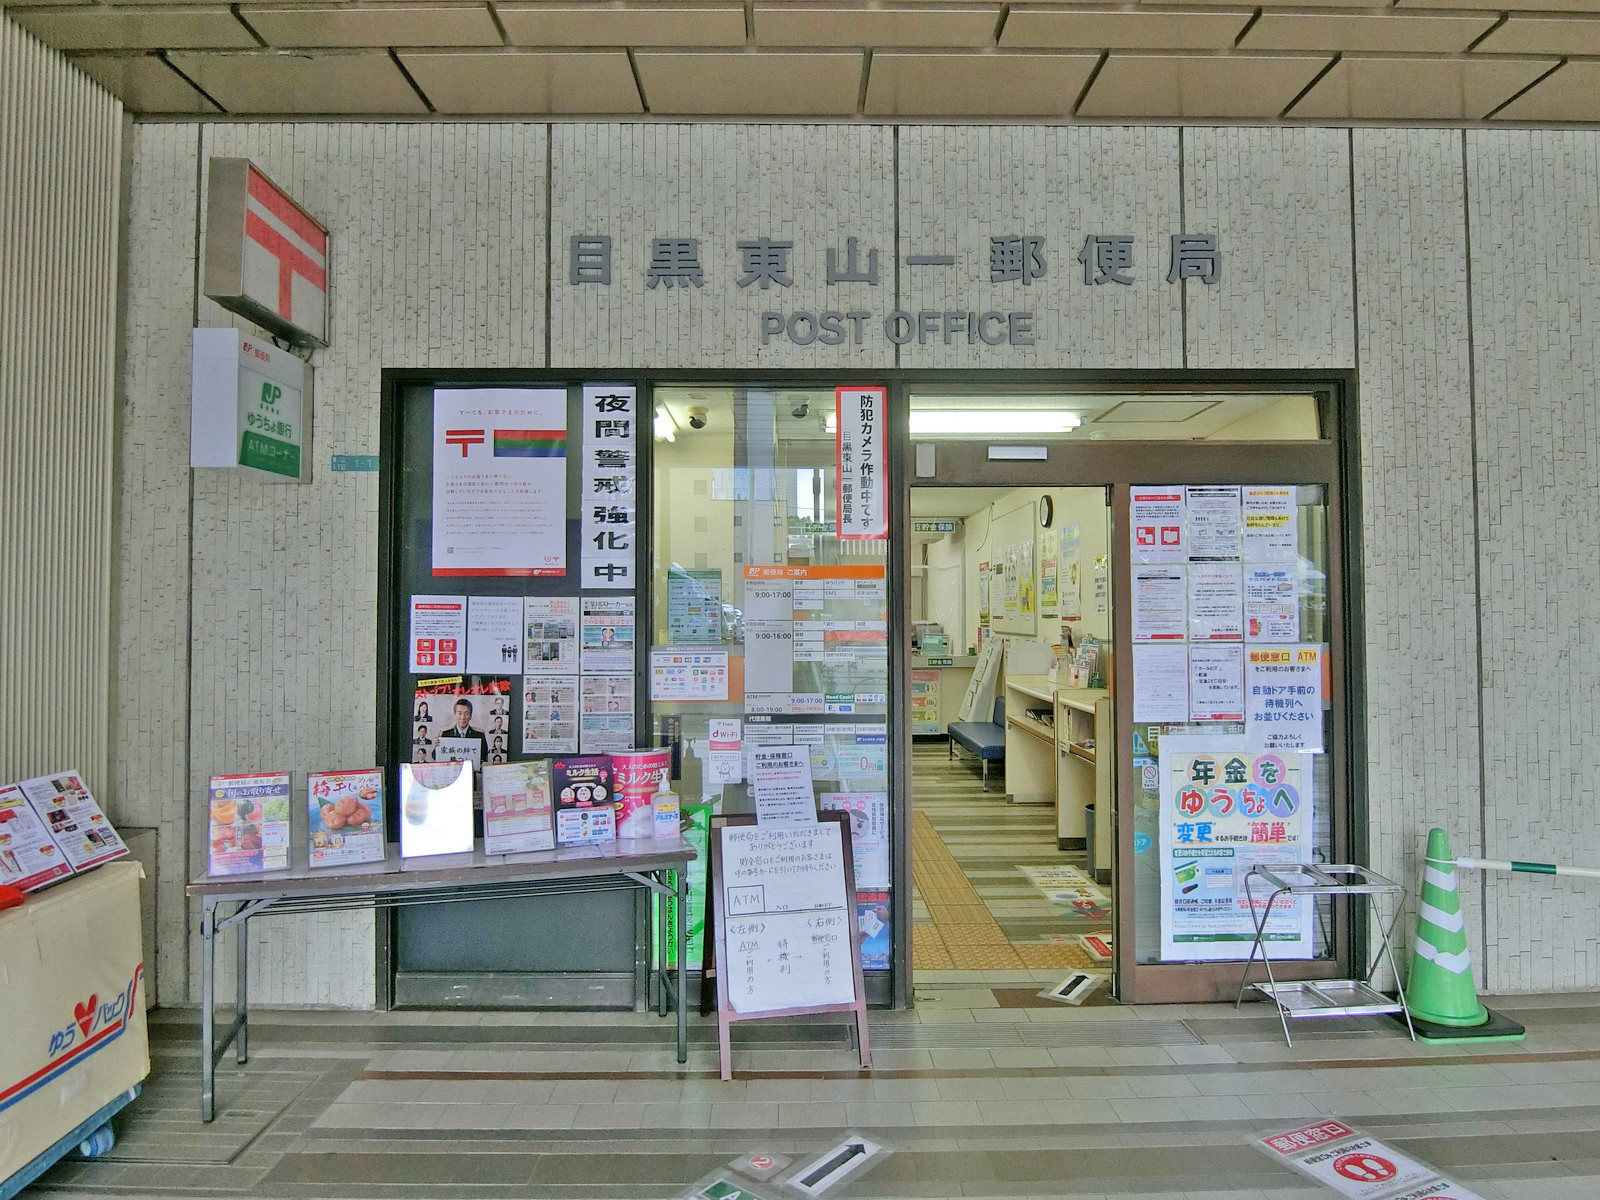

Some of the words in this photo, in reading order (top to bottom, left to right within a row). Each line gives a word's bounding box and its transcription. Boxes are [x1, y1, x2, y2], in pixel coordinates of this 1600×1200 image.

[568, 234, 1223, 290] 目黒東山一郵便局
[761, 311, 872, 346] POST
[885, 310, 1035, 347] OFFICE
[247, 411, 292, 439] ゆうちょ銀行
[860, 394, 874, 530] 防犯カメラ作動中です
[842, 430, 853, 525] 目黒東山一郵便局長
[593, 394, 632, 583] 夜間警戒強化中
[938, 523, 954, 532] 保険
[763, 568, 784, 577] 郵便局
[787, 568, 808, 577] ご案内
[754, 591, 791, 599] 9:00-17:00
[1250, 651, 1291, 662] 郵便窓口
[1297, 651, 1317, 662] ATM
[1252, 685, 1316, 696] 自動ドア手前の
[1265, 698, 1303, 709] 待機列へ
[1254, 711, 1314, 722] お並びください
[1267, 734, 1302, 742] ご協力よろしく
[755, 752, 793, 760] 貯金・保険窓口
[756, 761, 805, 769] ご利用のお客さまへ
[566, 768, 599, 777] ミルク生活
[1191, 758, 1279, 786] 年金を
[1180, 788, 1295, 815] ゆうちょへ
[1250, 821, 1287, 844] 簡単
[749, 840, 814, 852] ありがとうございます
[733, 893, 761, 908] ATM
[739, 941, 760, 951] ATM
[776, 938, 791, 976] 待機列
[48, 1021, 77, 1058] ゆう
[92, 991, 126, 1032] パック
[1269, 1122, 1349, 1152] 郵便窓口
